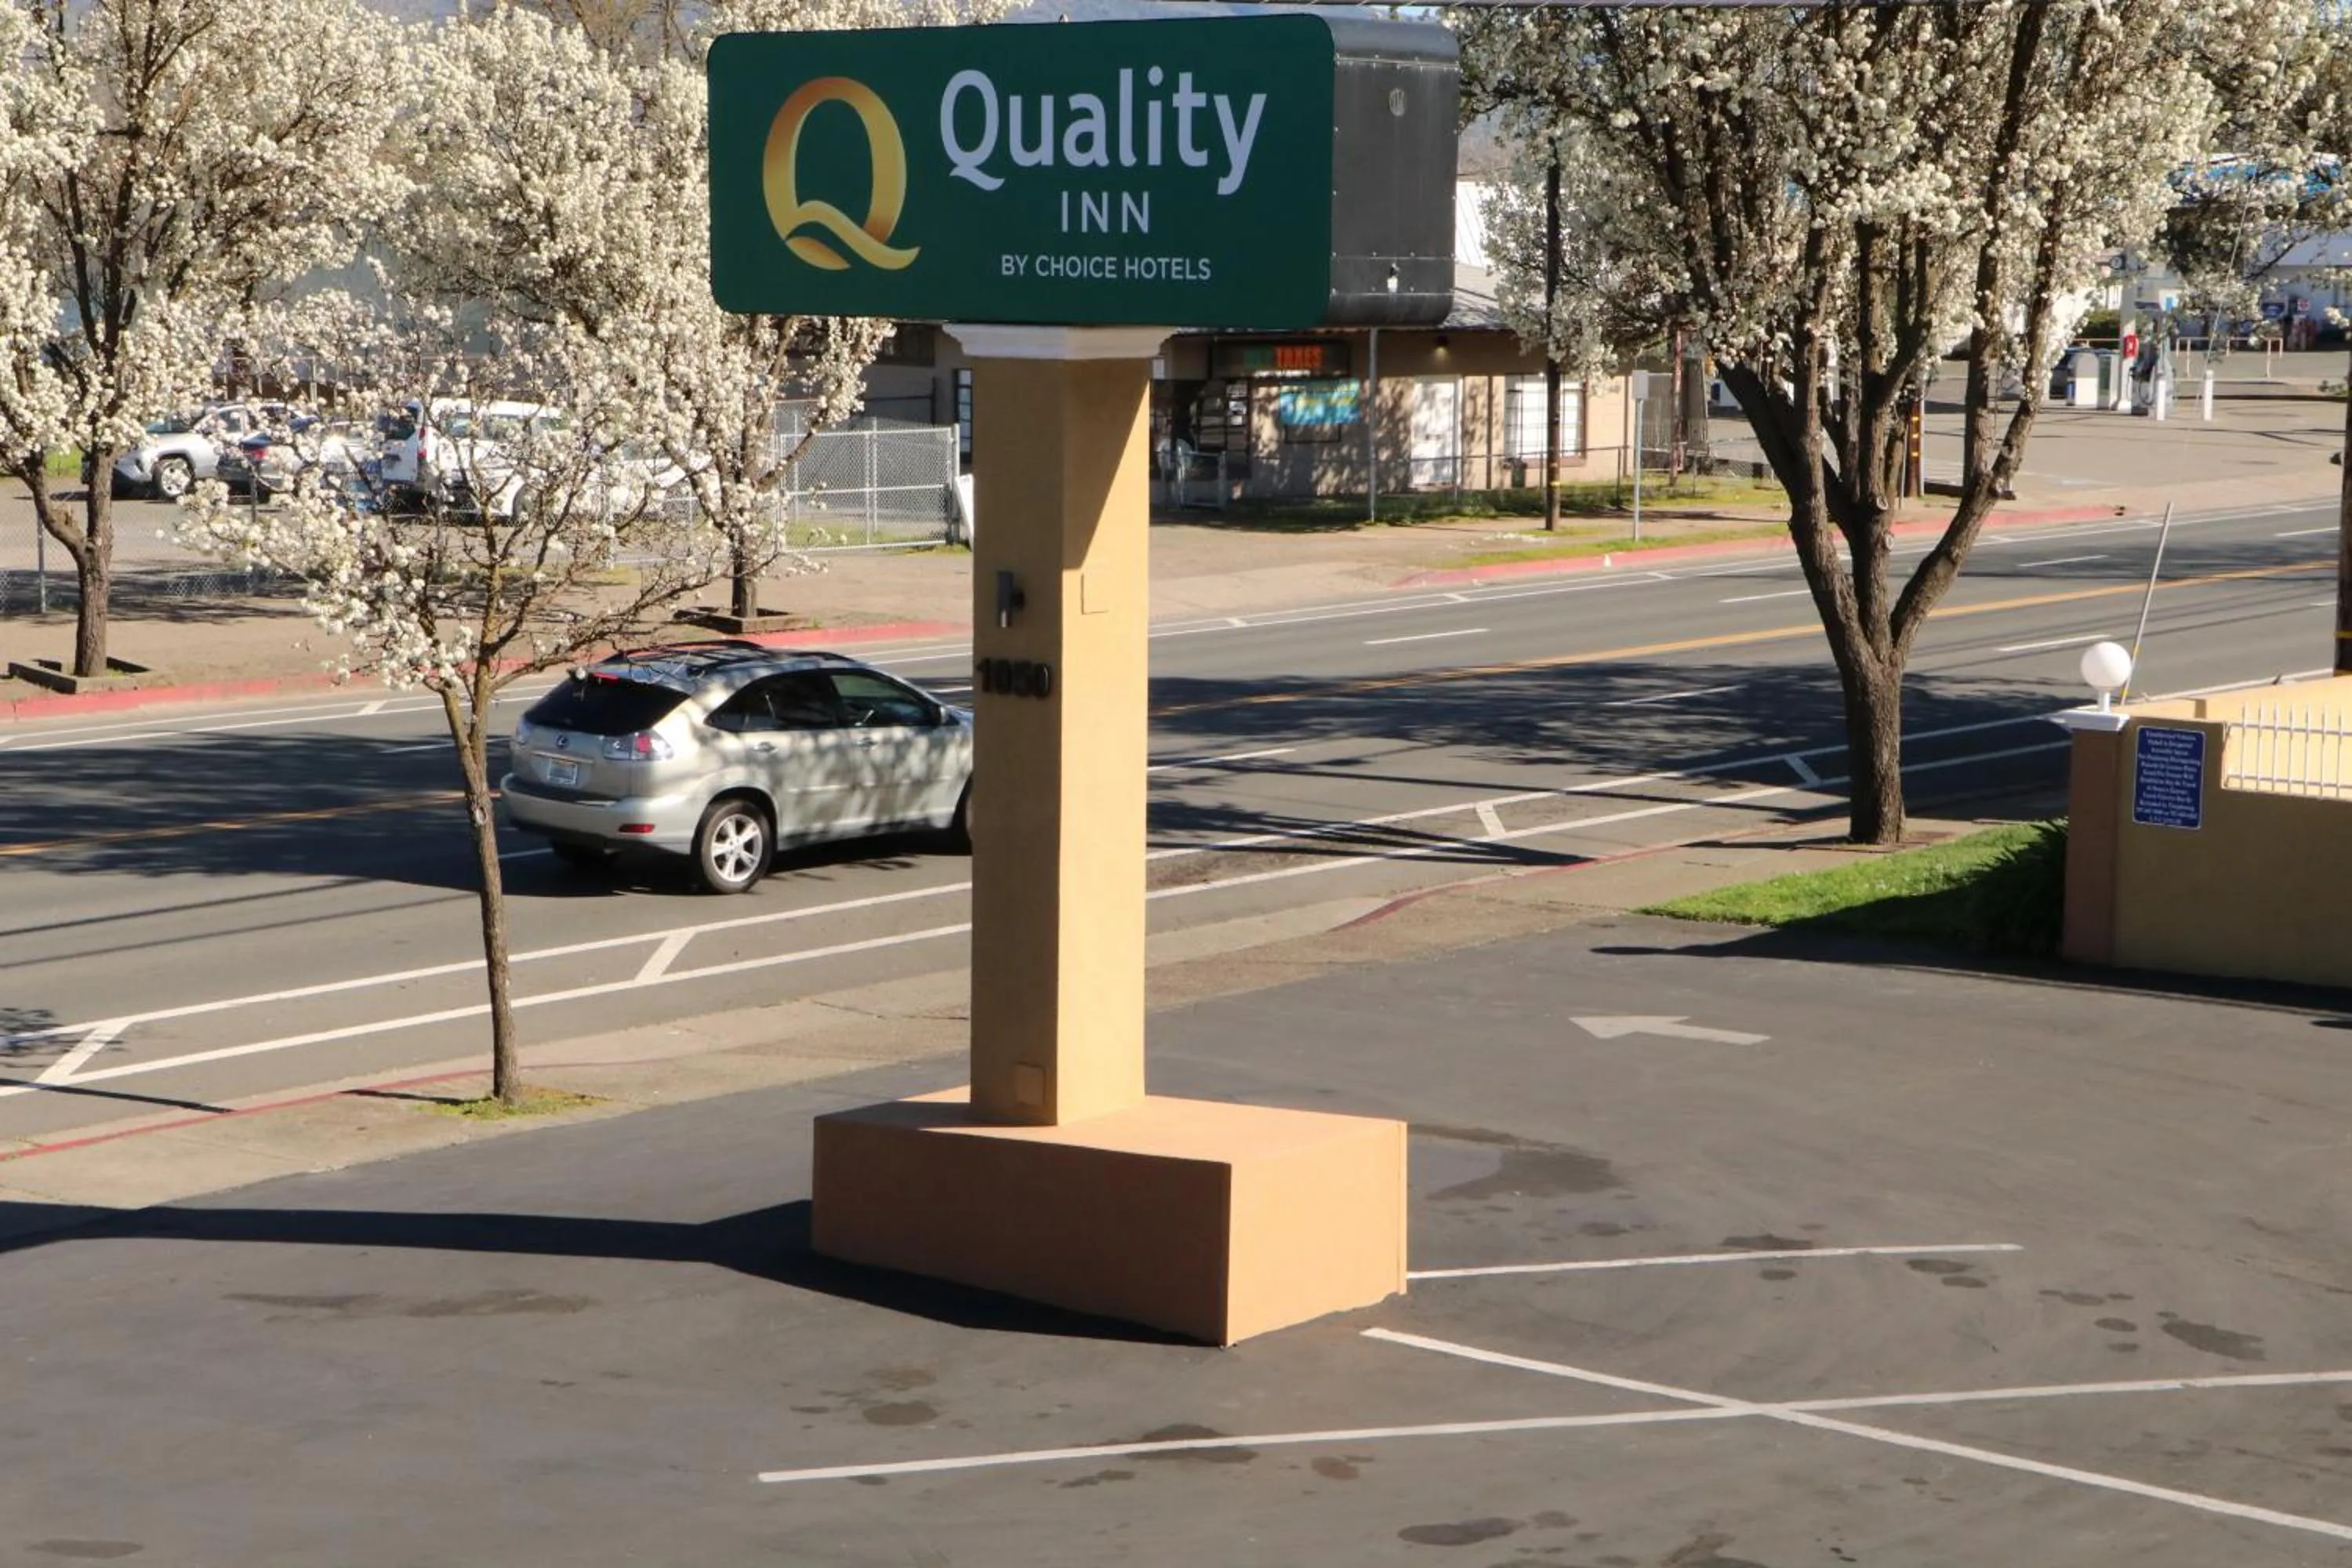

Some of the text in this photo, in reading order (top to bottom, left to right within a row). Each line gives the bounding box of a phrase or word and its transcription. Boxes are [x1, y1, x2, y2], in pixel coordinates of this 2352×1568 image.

[763, 76, 921, 270] Q
[941, 66, 1267, 195] Quality
[1061, 191, 1150, 233] INN
[1001, 255, 1211, 280] BY CHOICE HOTELS
